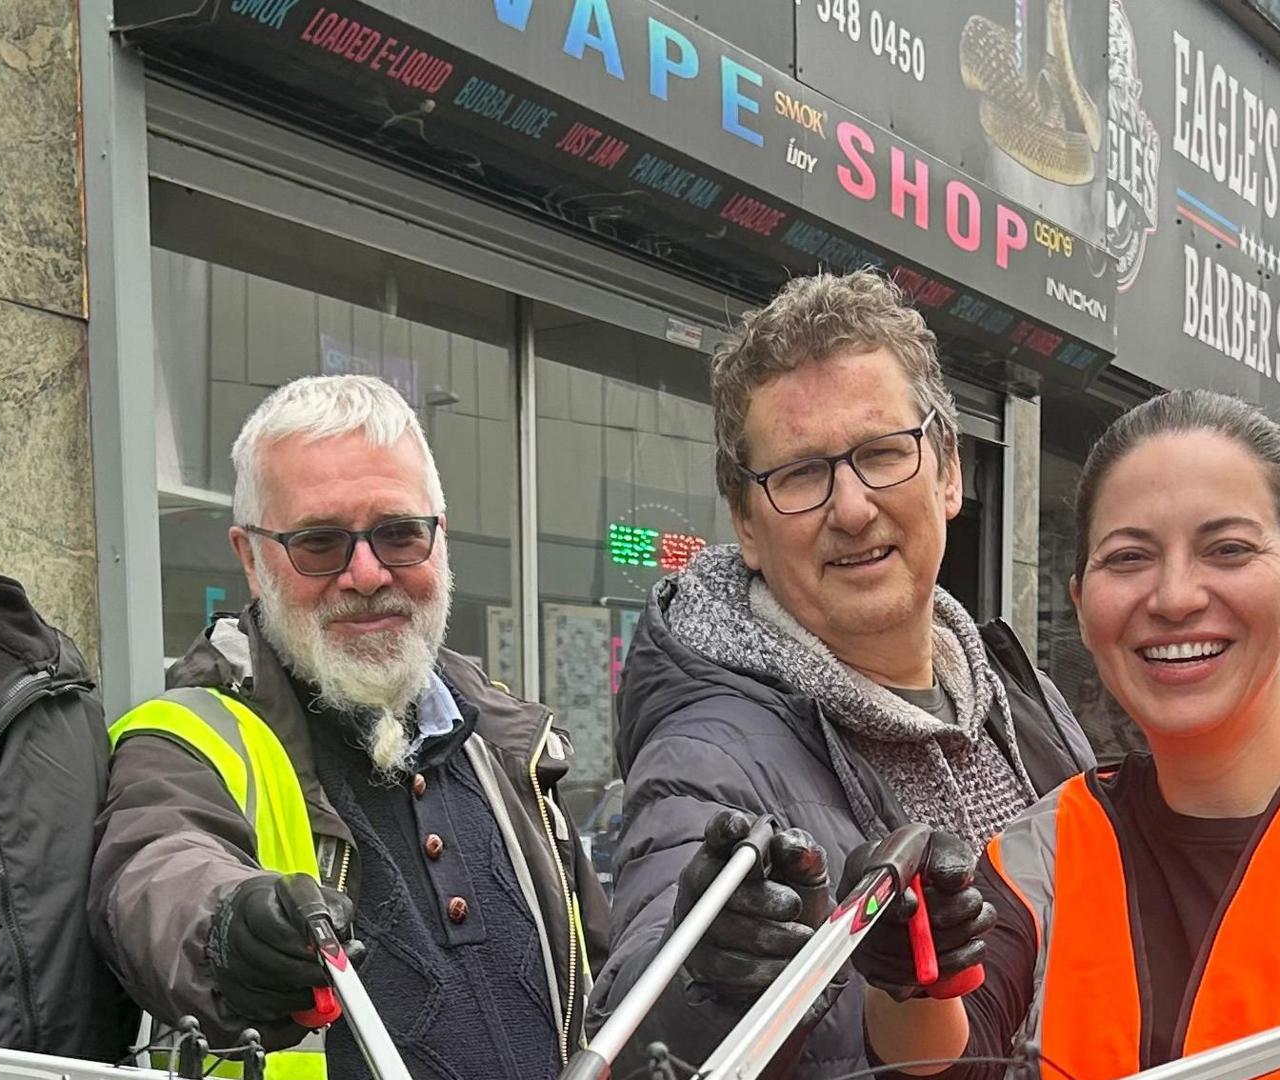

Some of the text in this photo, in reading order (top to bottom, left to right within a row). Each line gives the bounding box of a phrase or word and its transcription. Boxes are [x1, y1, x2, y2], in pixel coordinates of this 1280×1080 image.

[301, 7, 453, 94] LOADED E-LIQUID
[870, 10, 925, 81] 0450
[454, 76, 558, 139] BUBBA JUICE
[1173, 30, 1278, 219] EAGLE'S
[555, 121, 629, 170] JUST JAM
[628, 153, 722, 209] PANCAKE MAN
[836, 122, 1028, 270] SHOP
[1045, 276, 1108, 323] INNOKIN
[1183, 245, 1273, 380] BARBER
